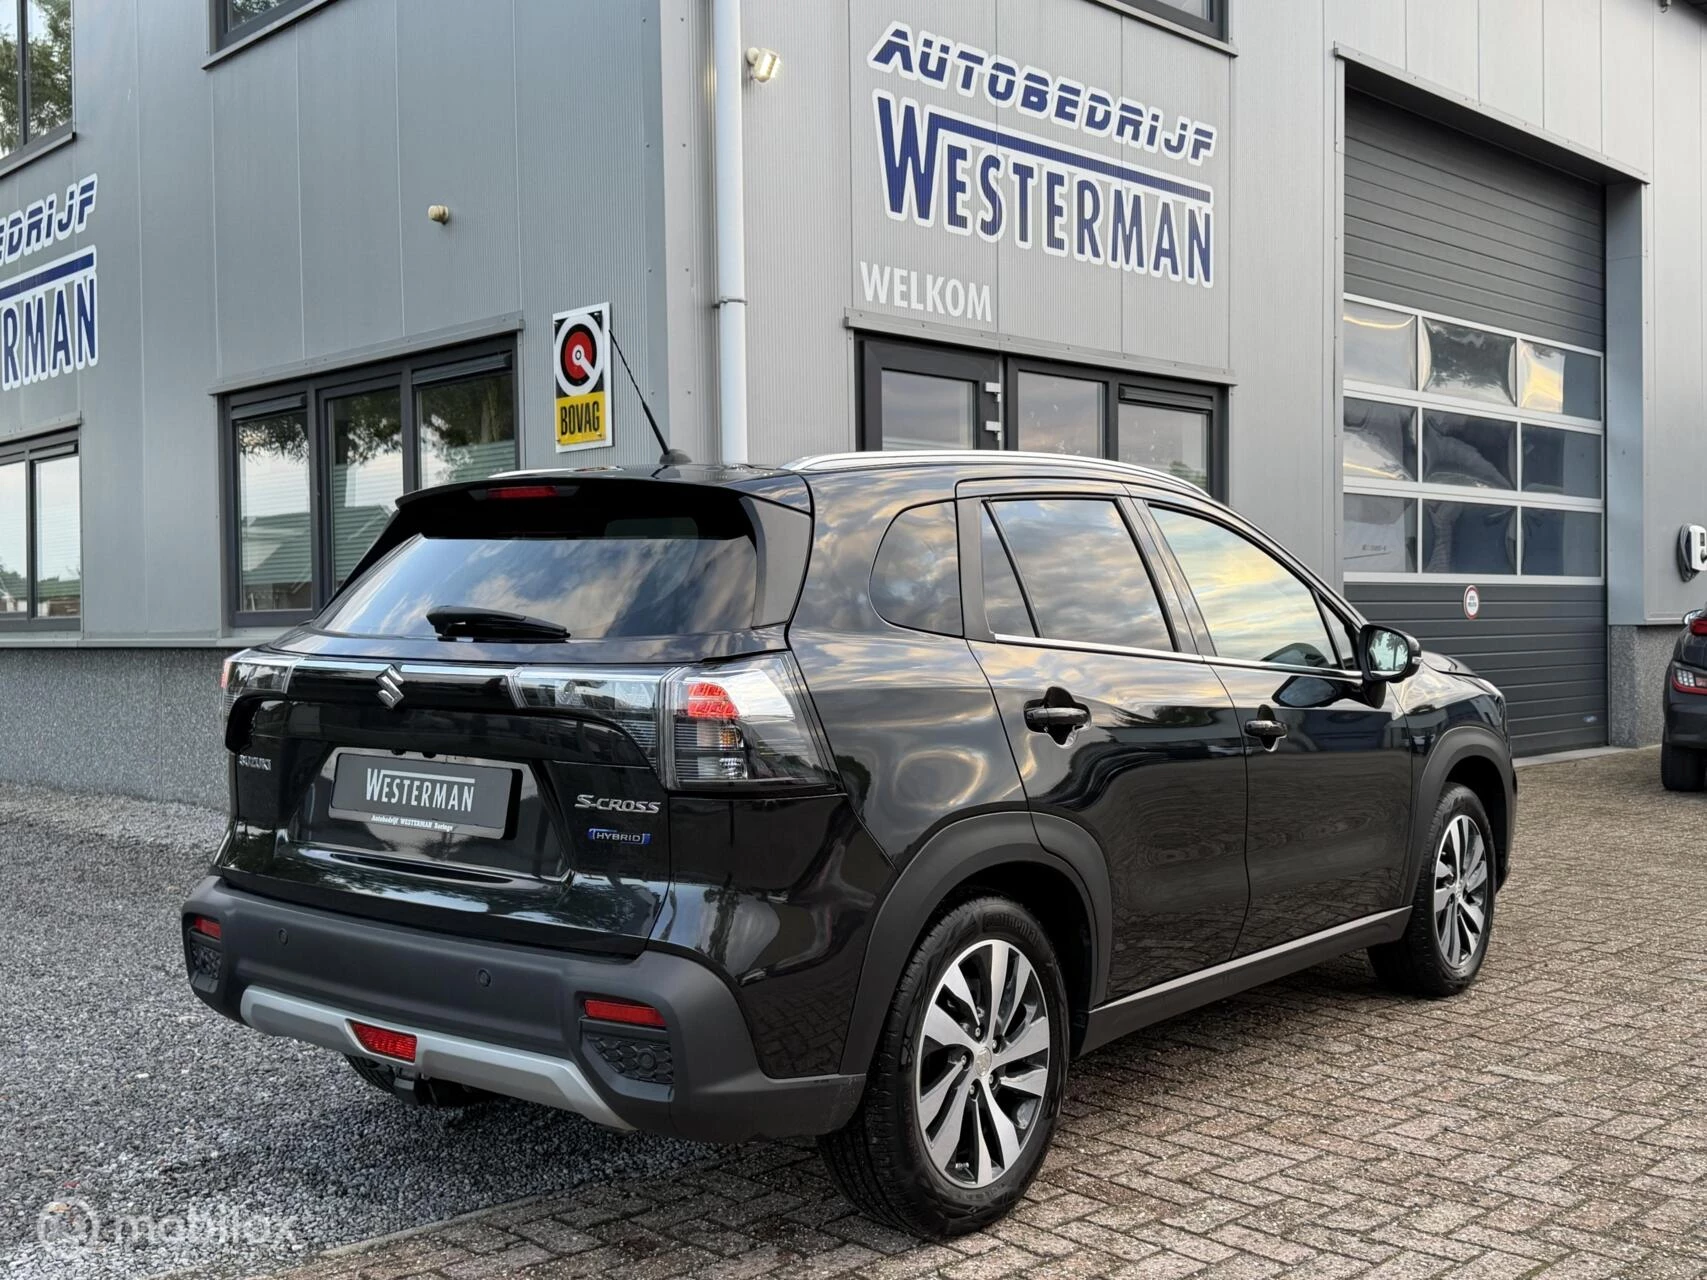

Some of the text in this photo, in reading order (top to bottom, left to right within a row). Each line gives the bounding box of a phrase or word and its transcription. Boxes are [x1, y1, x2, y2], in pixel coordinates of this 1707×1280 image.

[870, 24, 1215, 162] AUTOBEDRIJF
[875, 94, 1212, 284] WESTERMAN
[859, 260, 993, 322] WELKOM
[559, 401, 601, 436] BOVAG
[366, 767, 474, 812] WESTERMAN
[574, 794, 661, 813] S-CROSS
[400, 817, 433, 829] WESTERMAN
[593, 830, 644, 843] HYBRID
